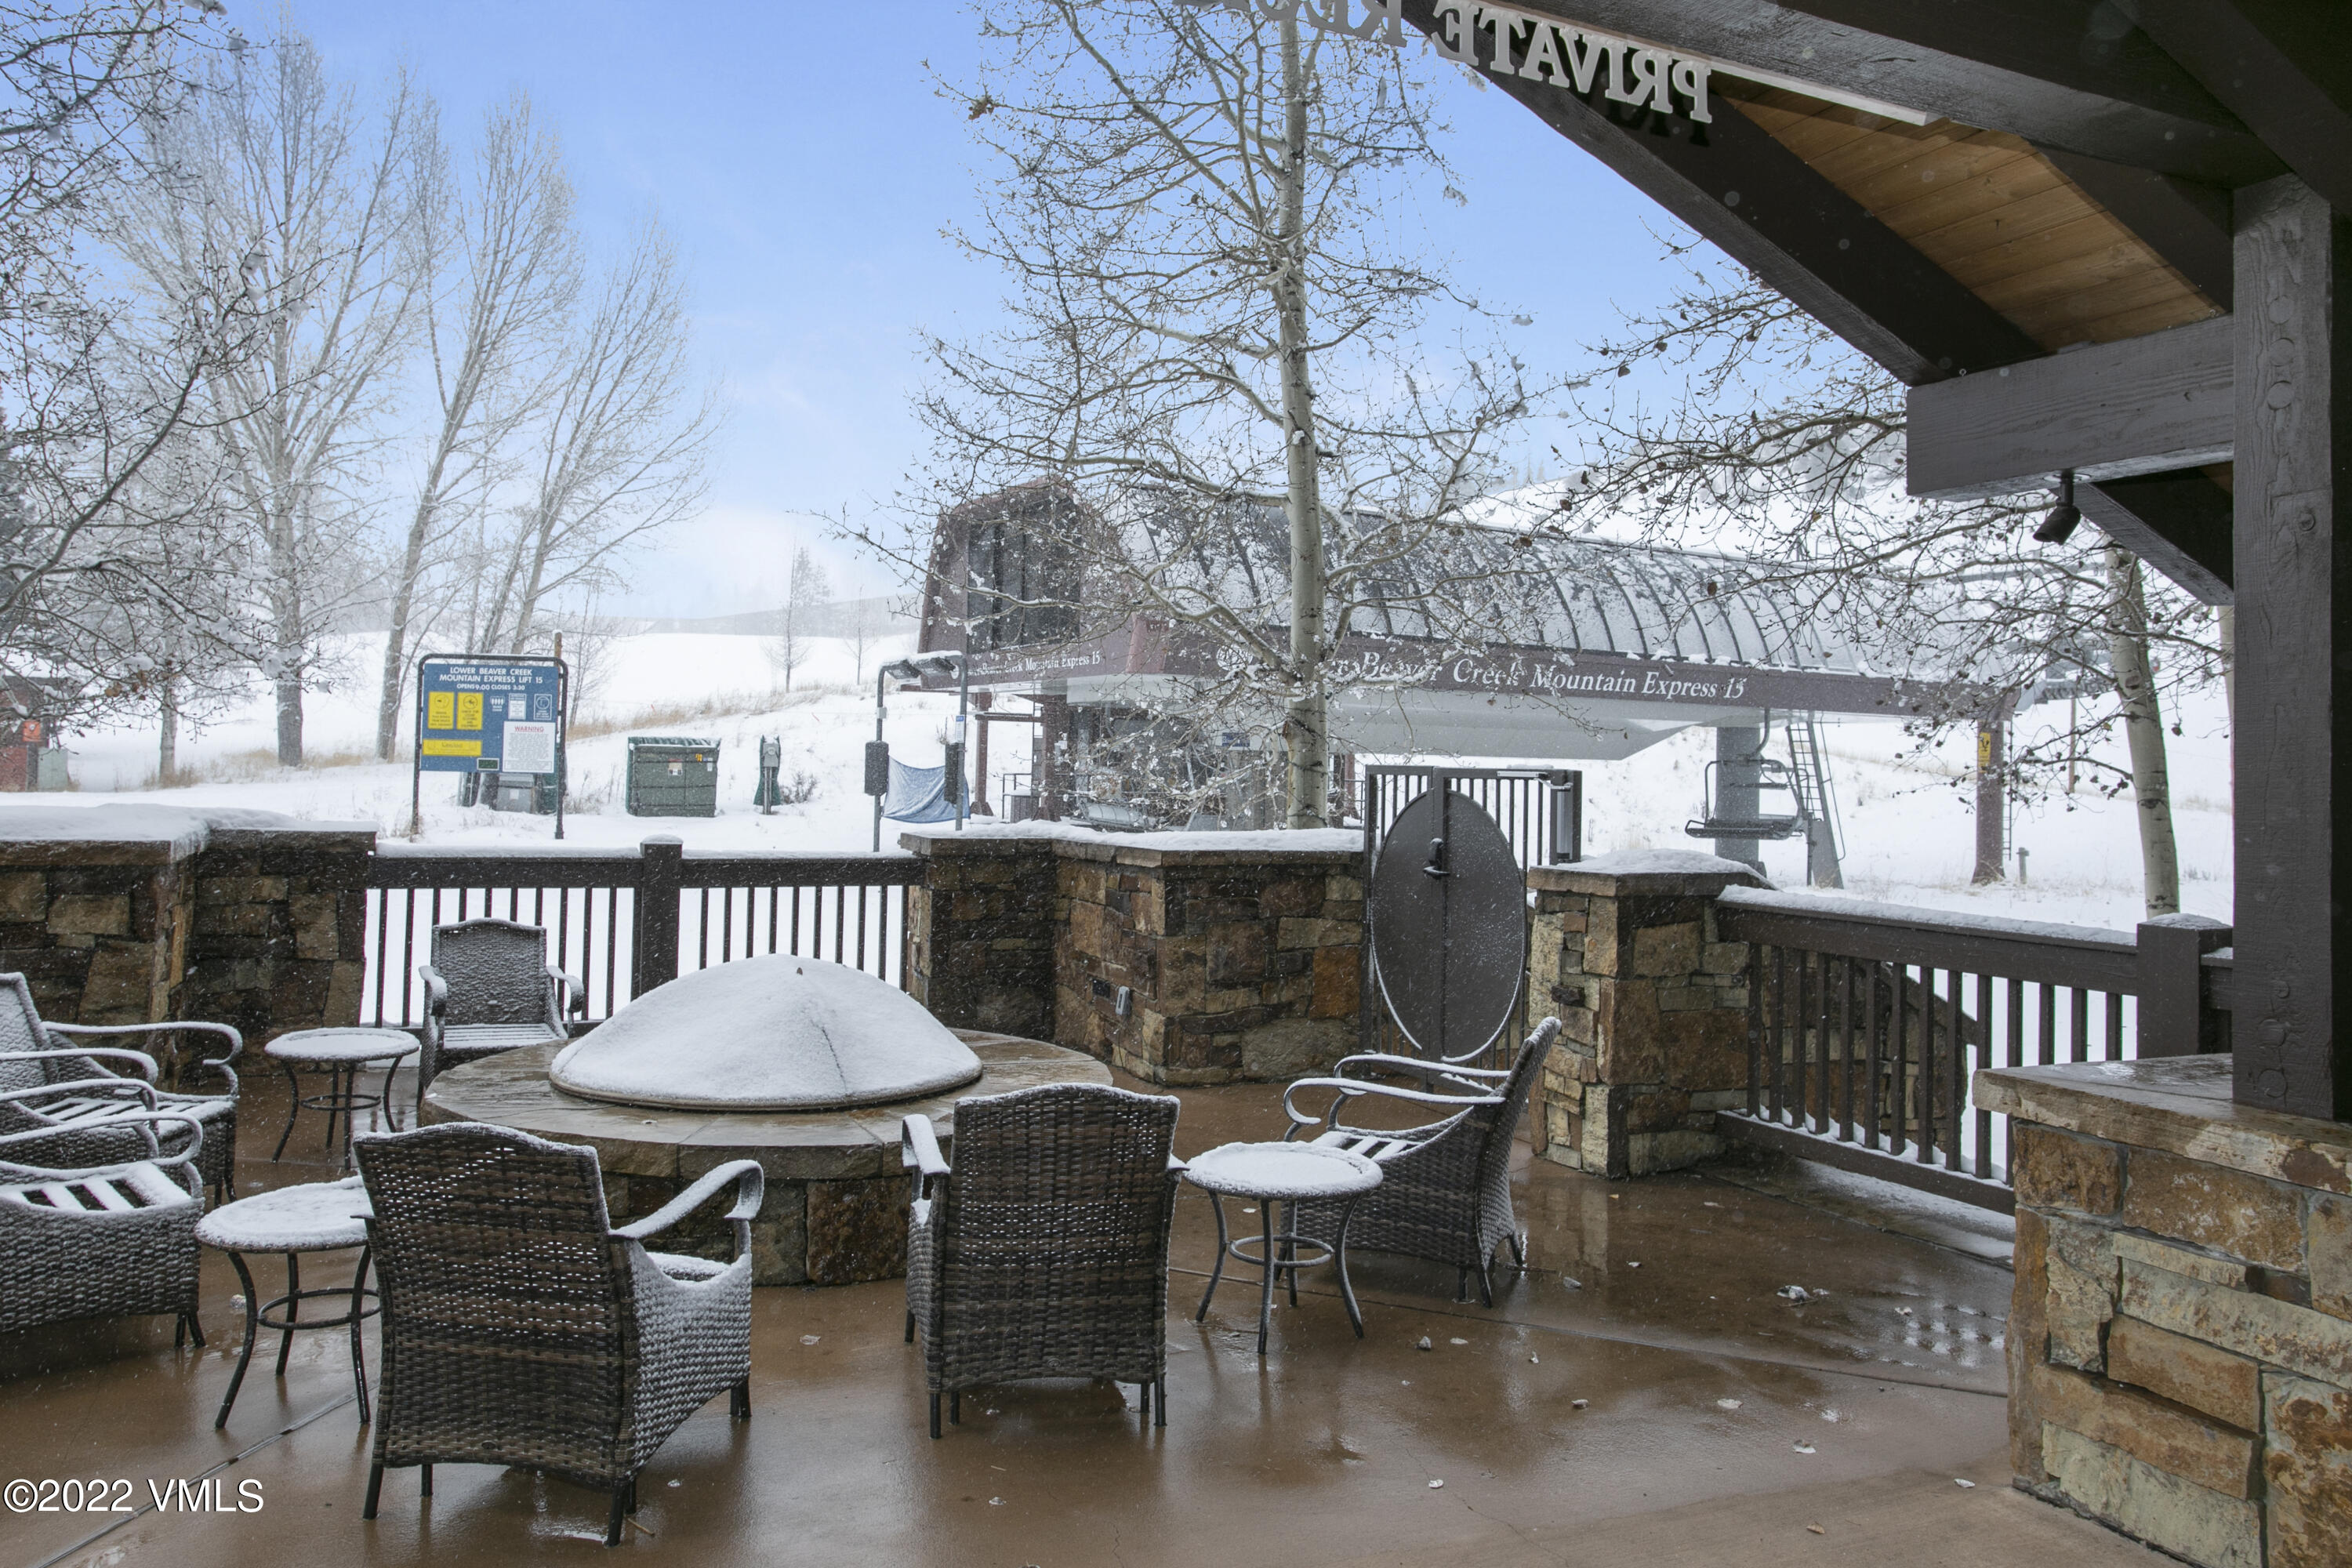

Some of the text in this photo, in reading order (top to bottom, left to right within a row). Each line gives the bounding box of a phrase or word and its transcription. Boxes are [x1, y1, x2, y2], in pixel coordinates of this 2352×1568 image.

[1062, 655, 1091, 669] Express
[1092, 651, 1101, 665] 15
[439, 673, 481, 682] MOUNTAIN
[1454, 659, 1519, 686] Creek
[1530, 664, 1636, 693] Mountain
[1642, 672, 1717, 699] Express
[1723, 677, 1748, 699] 15
